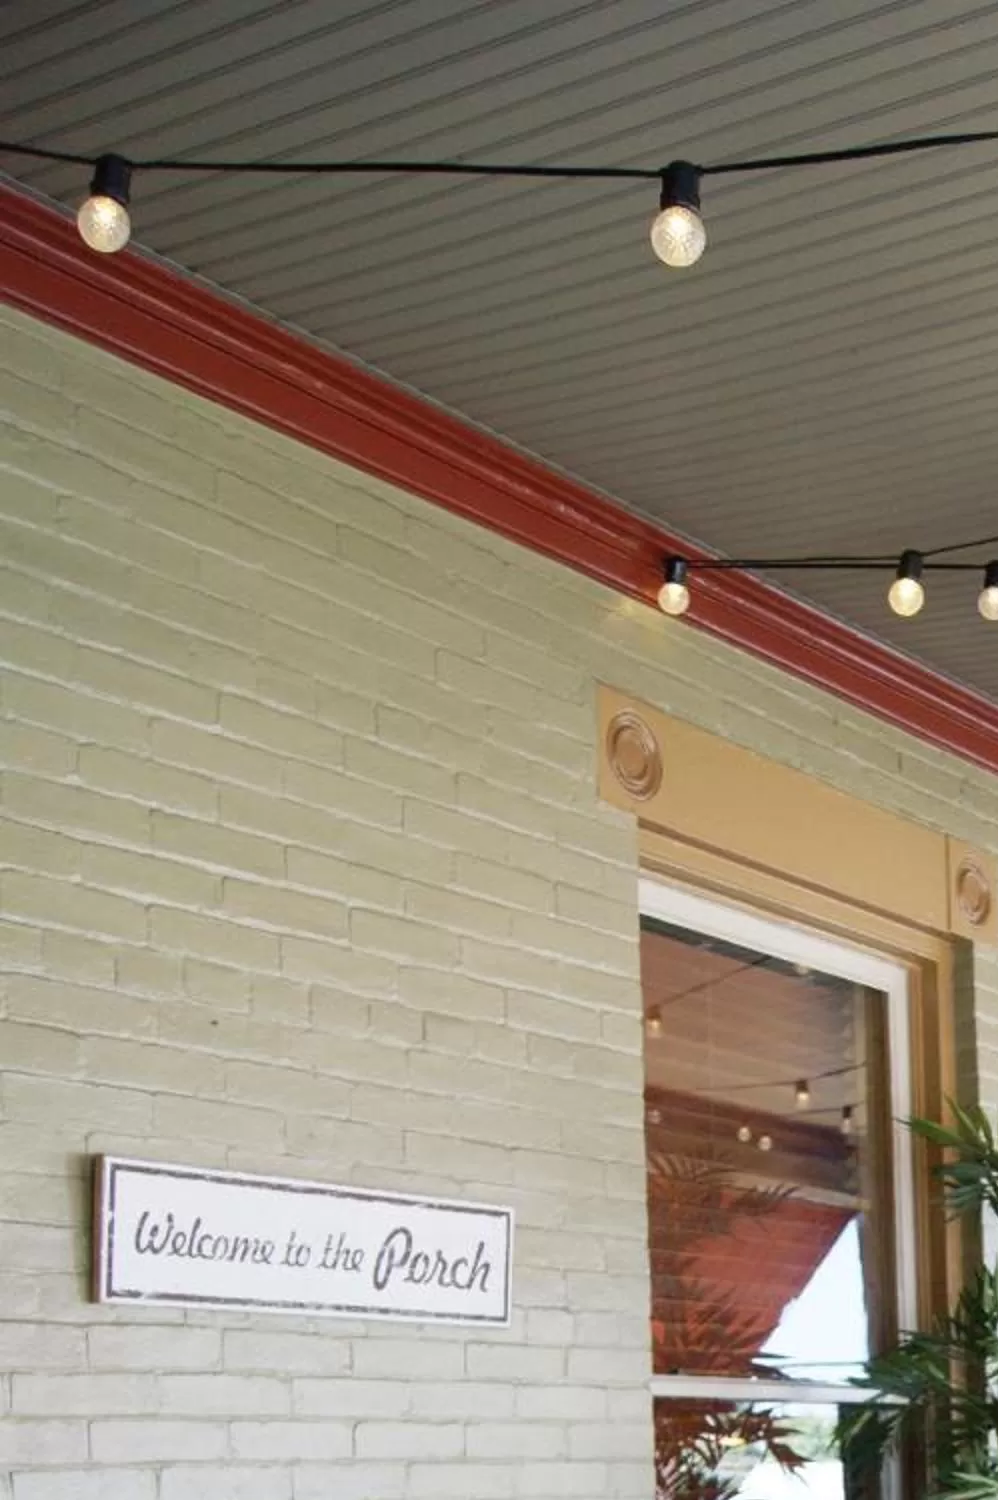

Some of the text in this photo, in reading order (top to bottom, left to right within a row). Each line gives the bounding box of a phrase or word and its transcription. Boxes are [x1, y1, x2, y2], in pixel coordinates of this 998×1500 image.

[134, 1210, 492, 1292] Welcome to the Porch
